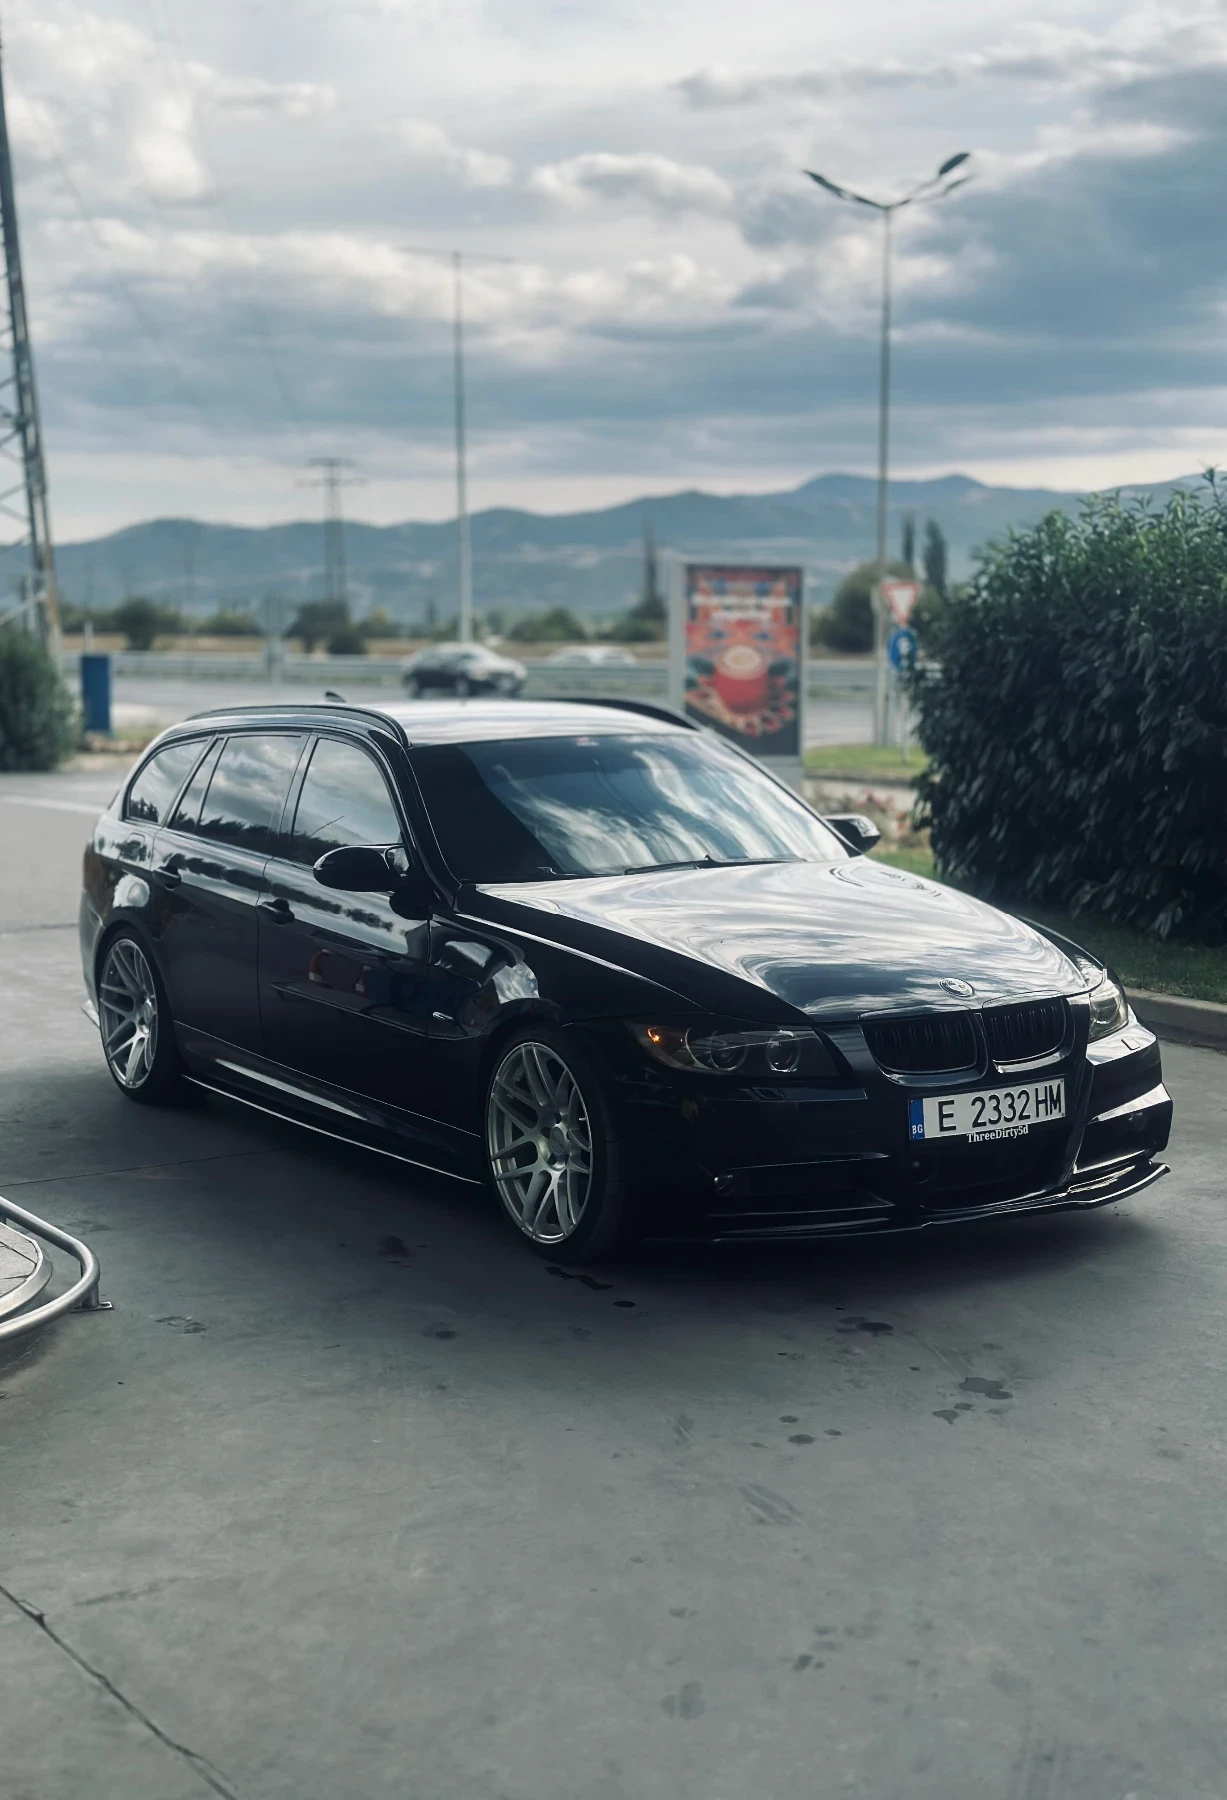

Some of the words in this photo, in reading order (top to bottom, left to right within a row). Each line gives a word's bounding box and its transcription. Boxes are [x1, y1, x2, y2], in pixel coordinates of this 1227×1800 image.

[938, 1099, 957, 1132] E
[971, 1089, 1031, 1128] 2332
[1034, 1083, 1062, 1118] HM
[912, 1124, 923, 1134] BG
